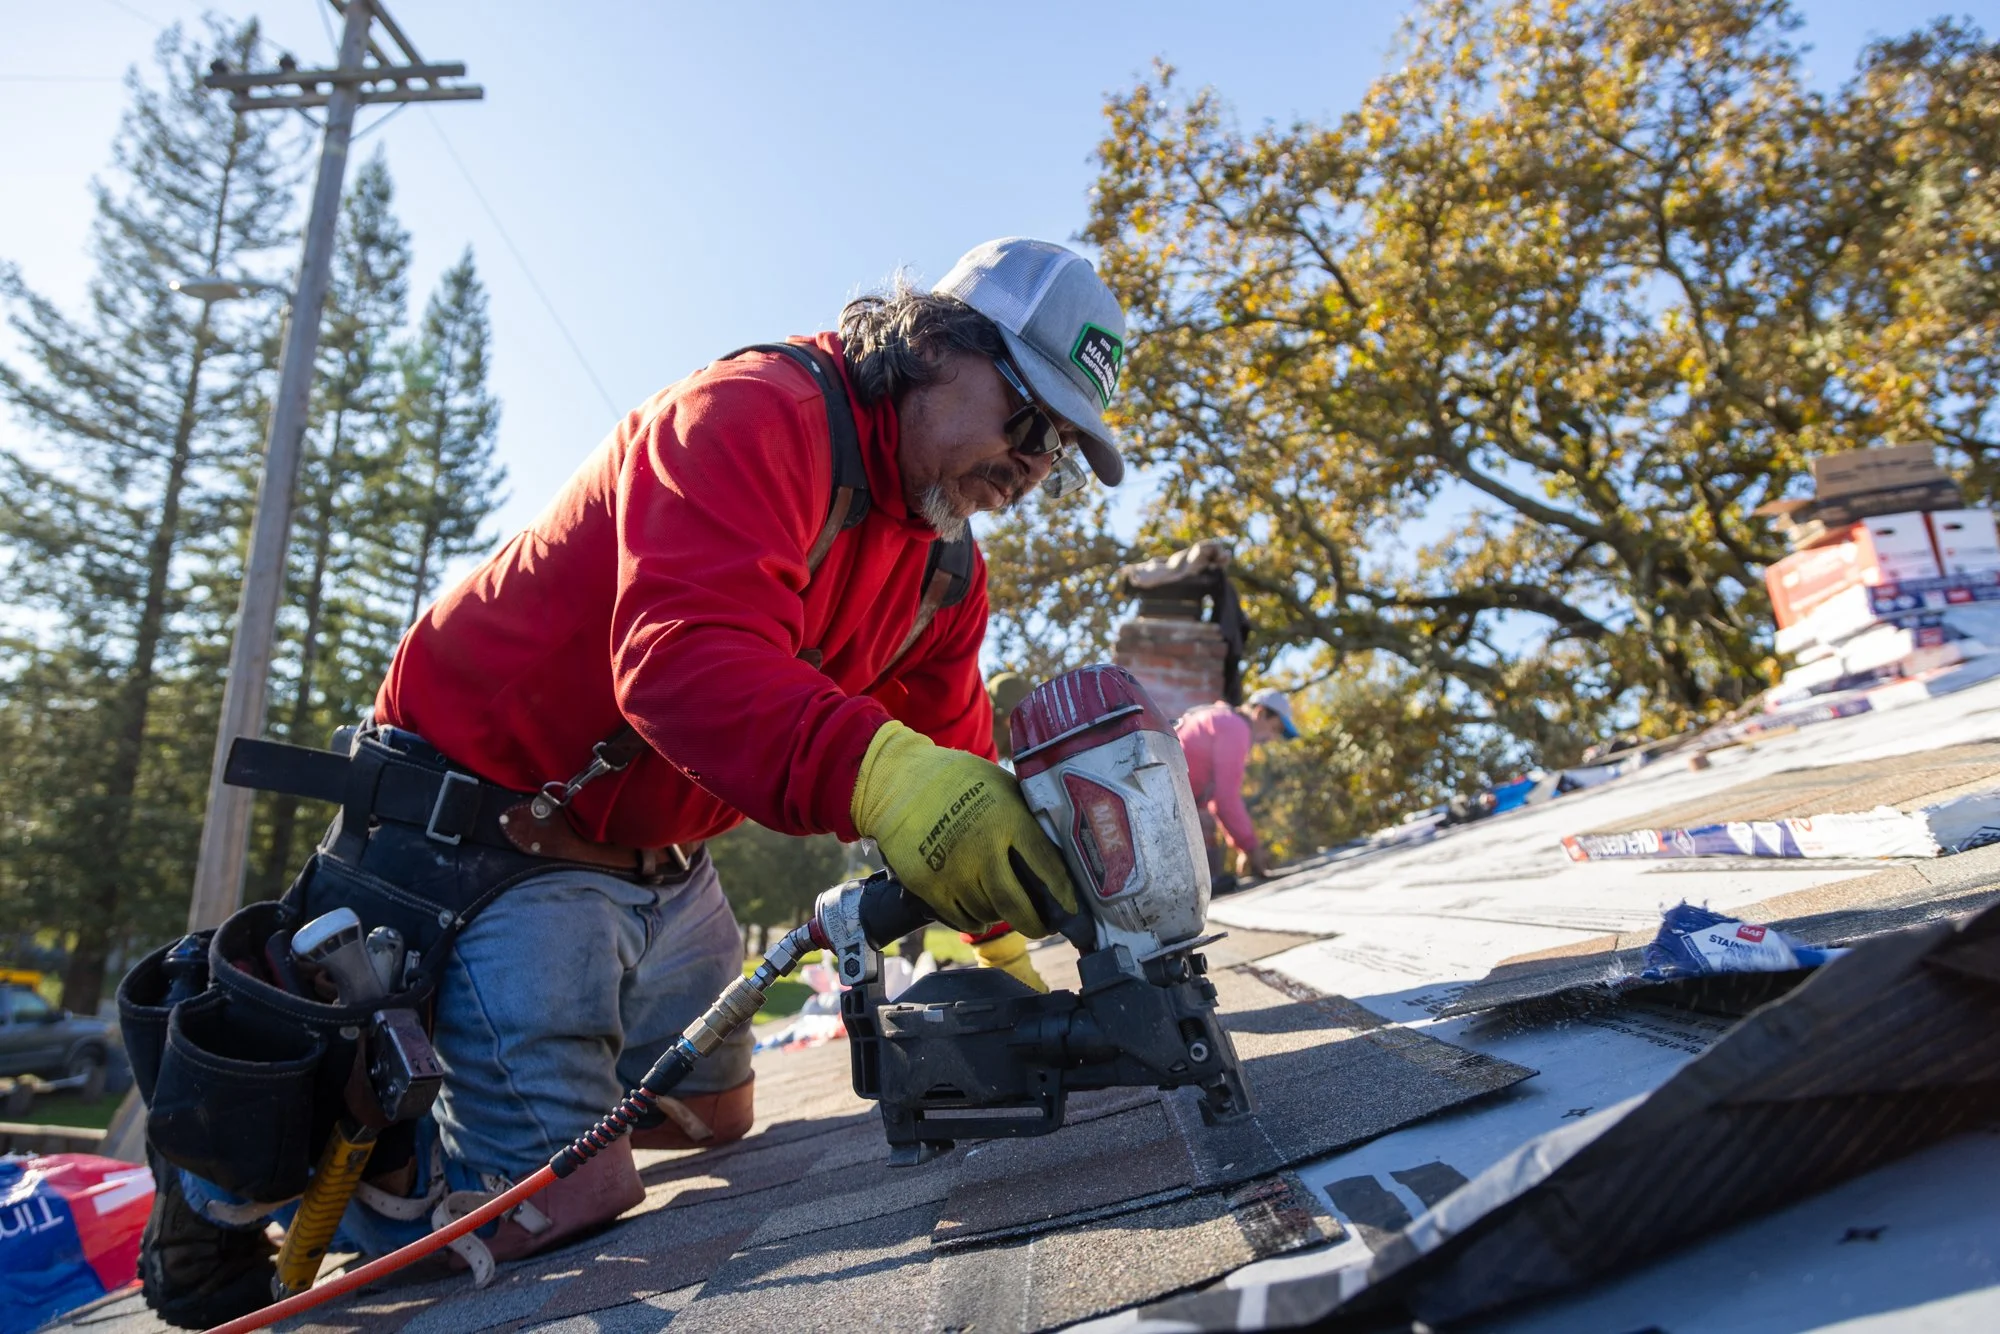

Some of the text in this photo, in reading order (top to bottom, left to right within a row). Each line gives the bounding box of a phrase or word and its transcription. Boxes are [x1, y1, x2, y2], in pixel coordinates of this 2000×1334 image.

[918, 813, 951, 856] FIRM
[950, 781, 985, 816] GRIP
[1092, 804, 1123, 851] MAX
[1740, 926, 1764, 938] GAF
